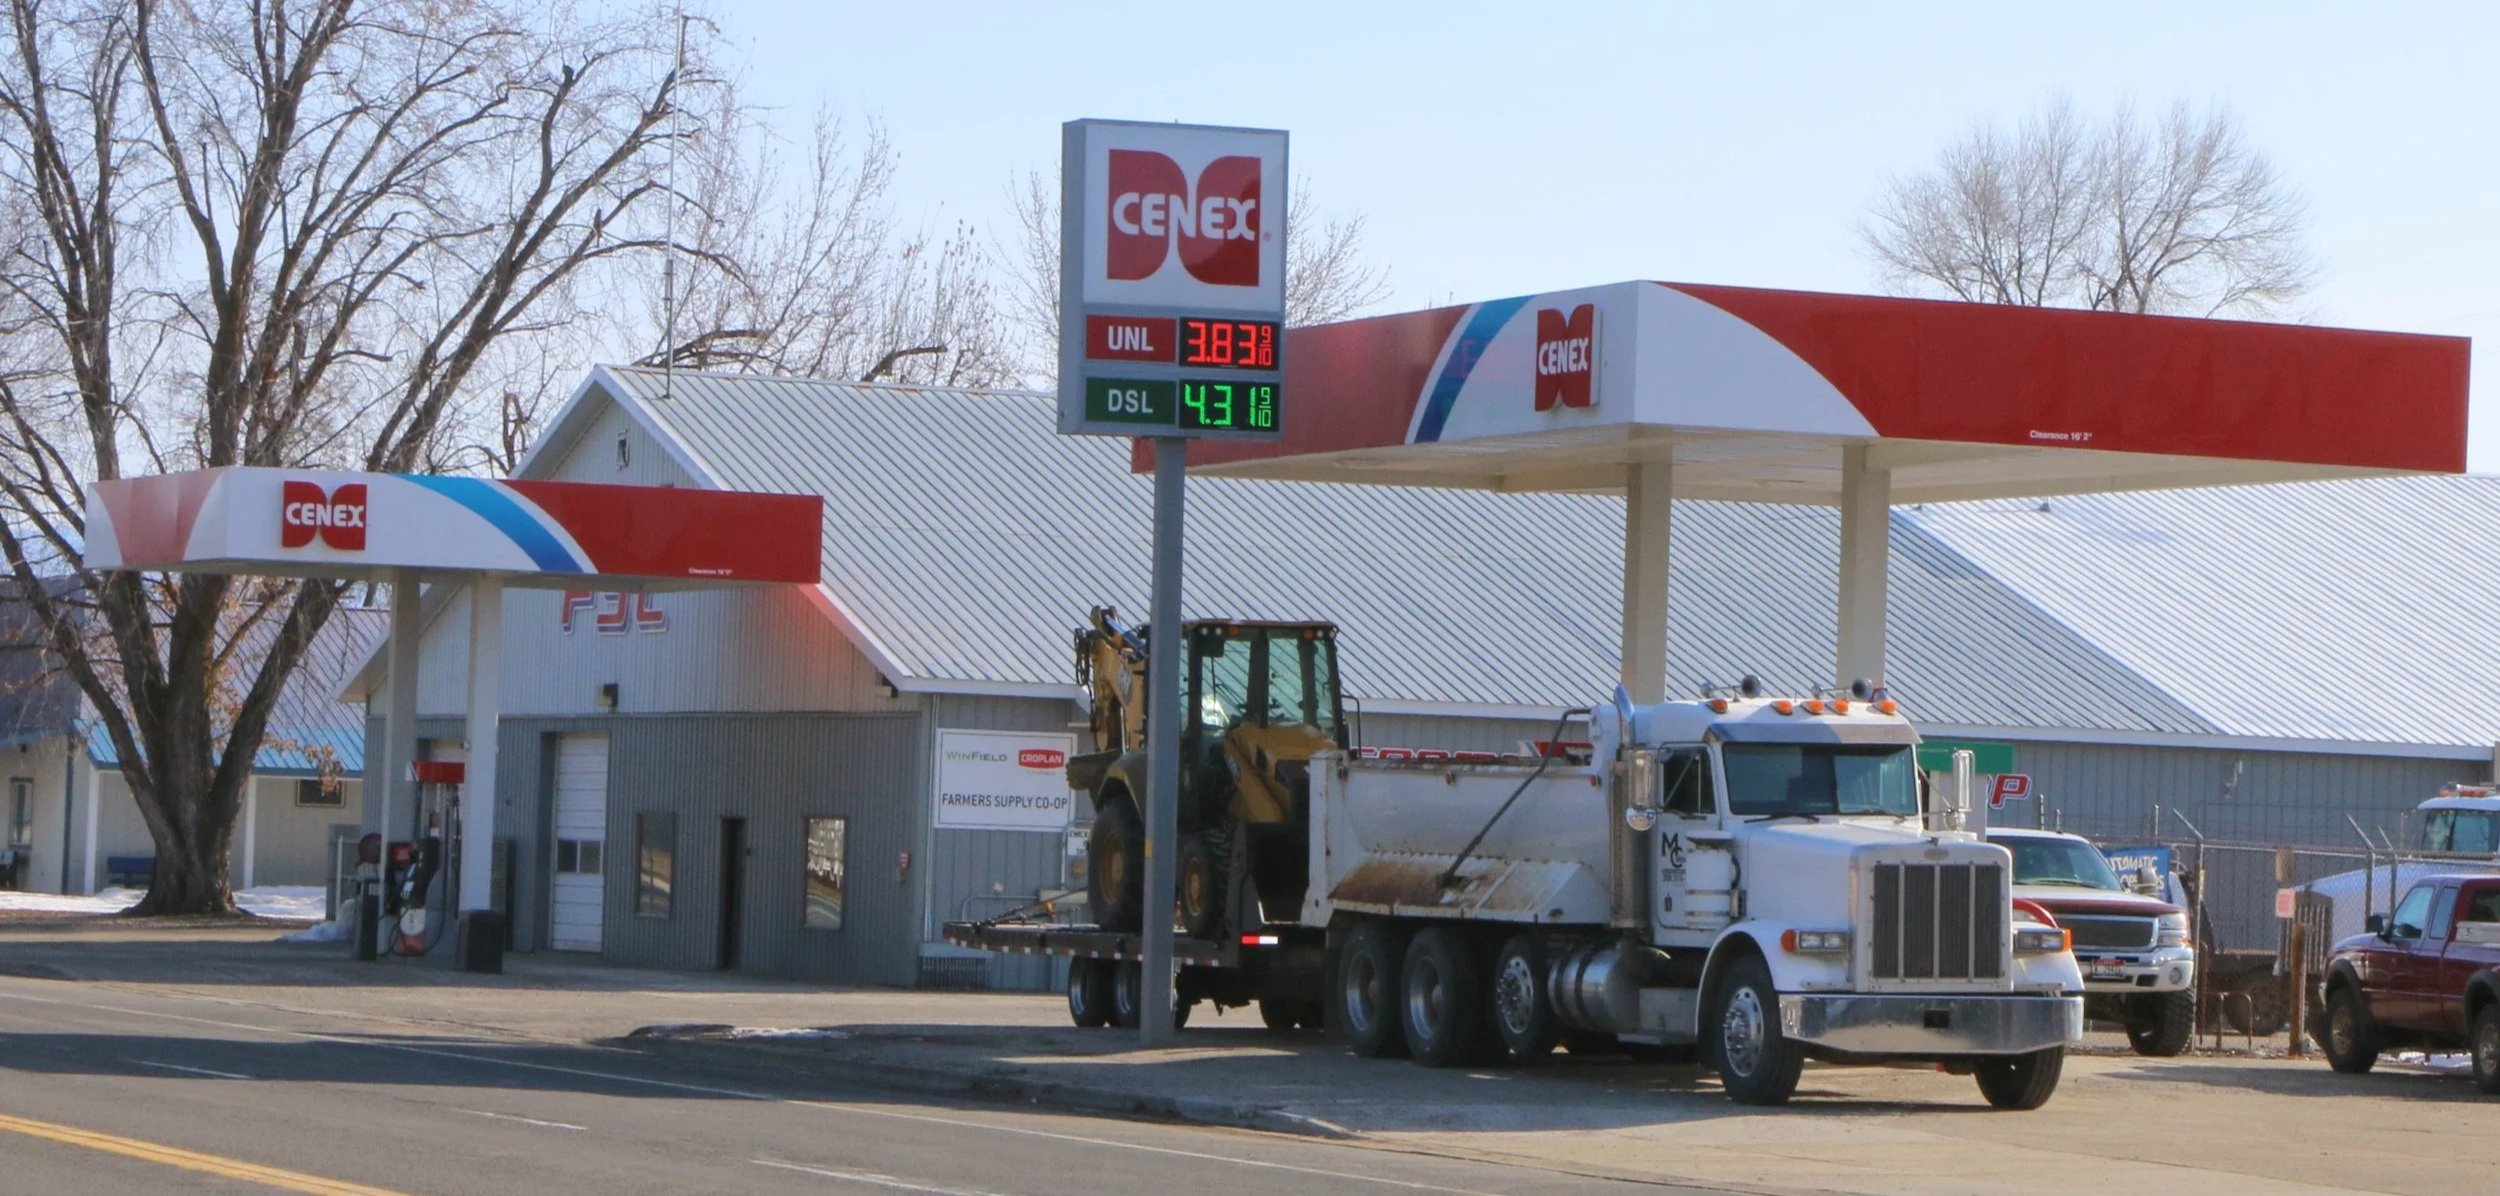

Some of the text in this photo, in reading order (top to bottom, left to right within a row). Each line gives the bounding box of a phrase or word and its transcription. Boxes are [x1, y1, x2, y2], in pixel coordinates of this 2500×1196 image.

[1113, 192, 1256, 241] CENEX
[1108, 325, 1154, 352] UNL
[1539, 338, 1589, 375] CENEX
[1108, 389, 1154, 414] DSL
[2029, 430, 2069, 441] Clearance
[286, 502, 364, 527] CENEX
[1021, 753, 1063, 764] CROPLAN
[942, 793, 1068, 810] FARMERS SUPPLY CO-OP
[2107, 856, 2158, 872] UTOMATIC
